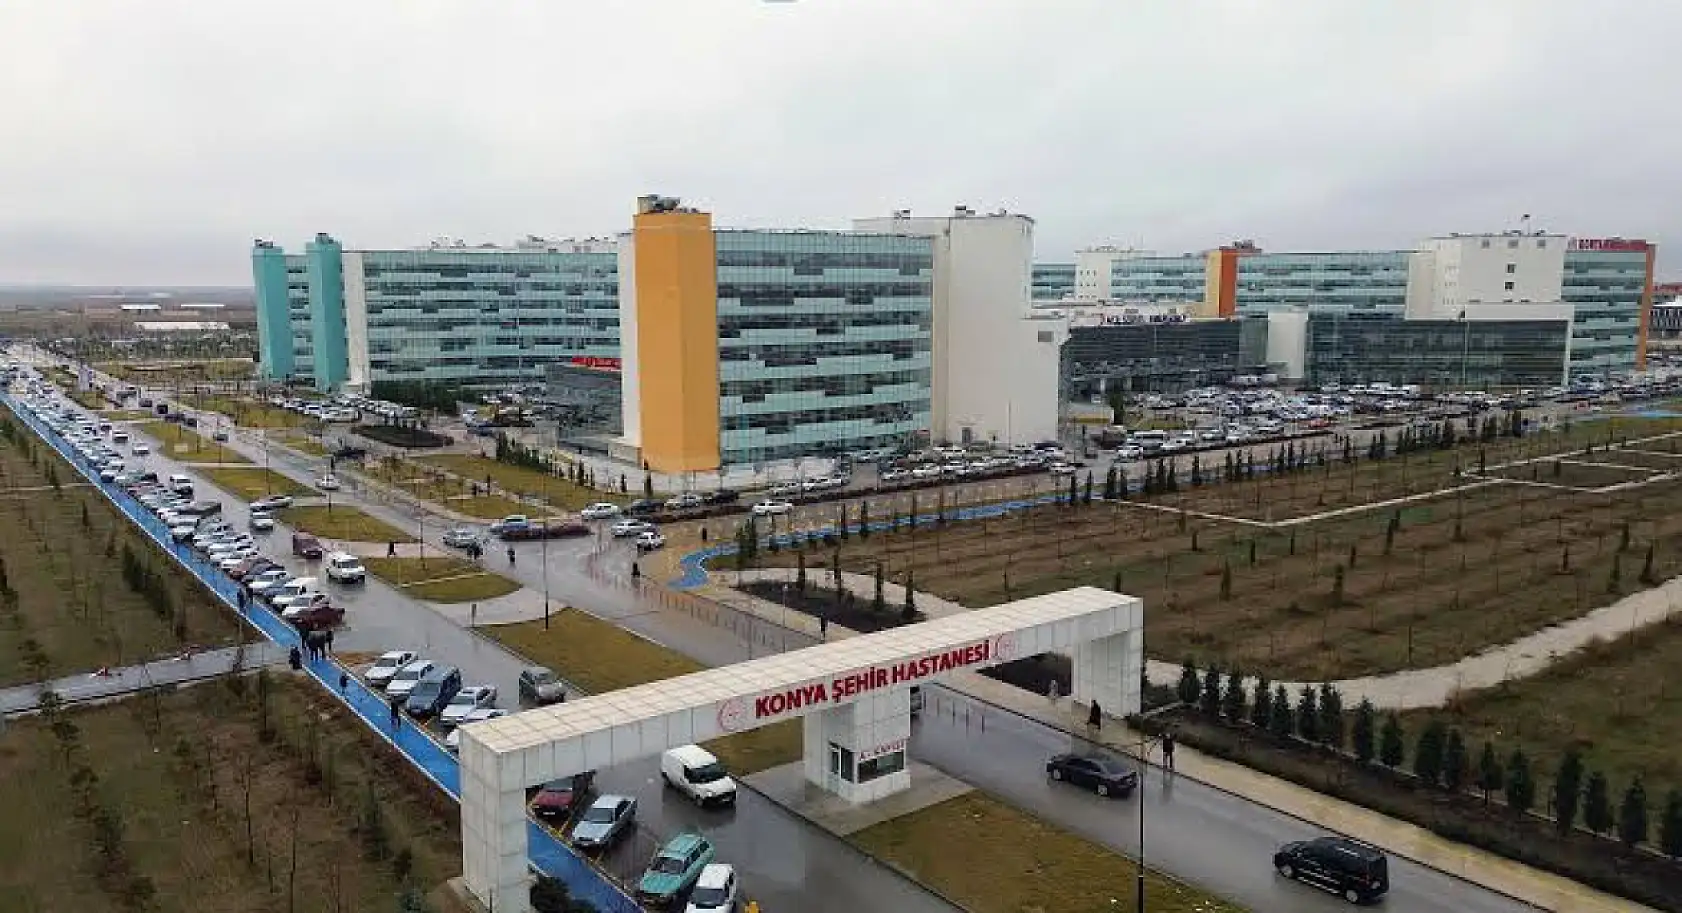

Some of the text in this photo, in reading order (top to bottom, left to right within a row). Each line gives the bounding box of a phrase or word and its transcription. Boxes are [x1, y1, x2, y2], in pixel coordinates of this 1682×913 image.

[756, 639, 990, 719] KONYA ŞEHİR HASTANESİ
